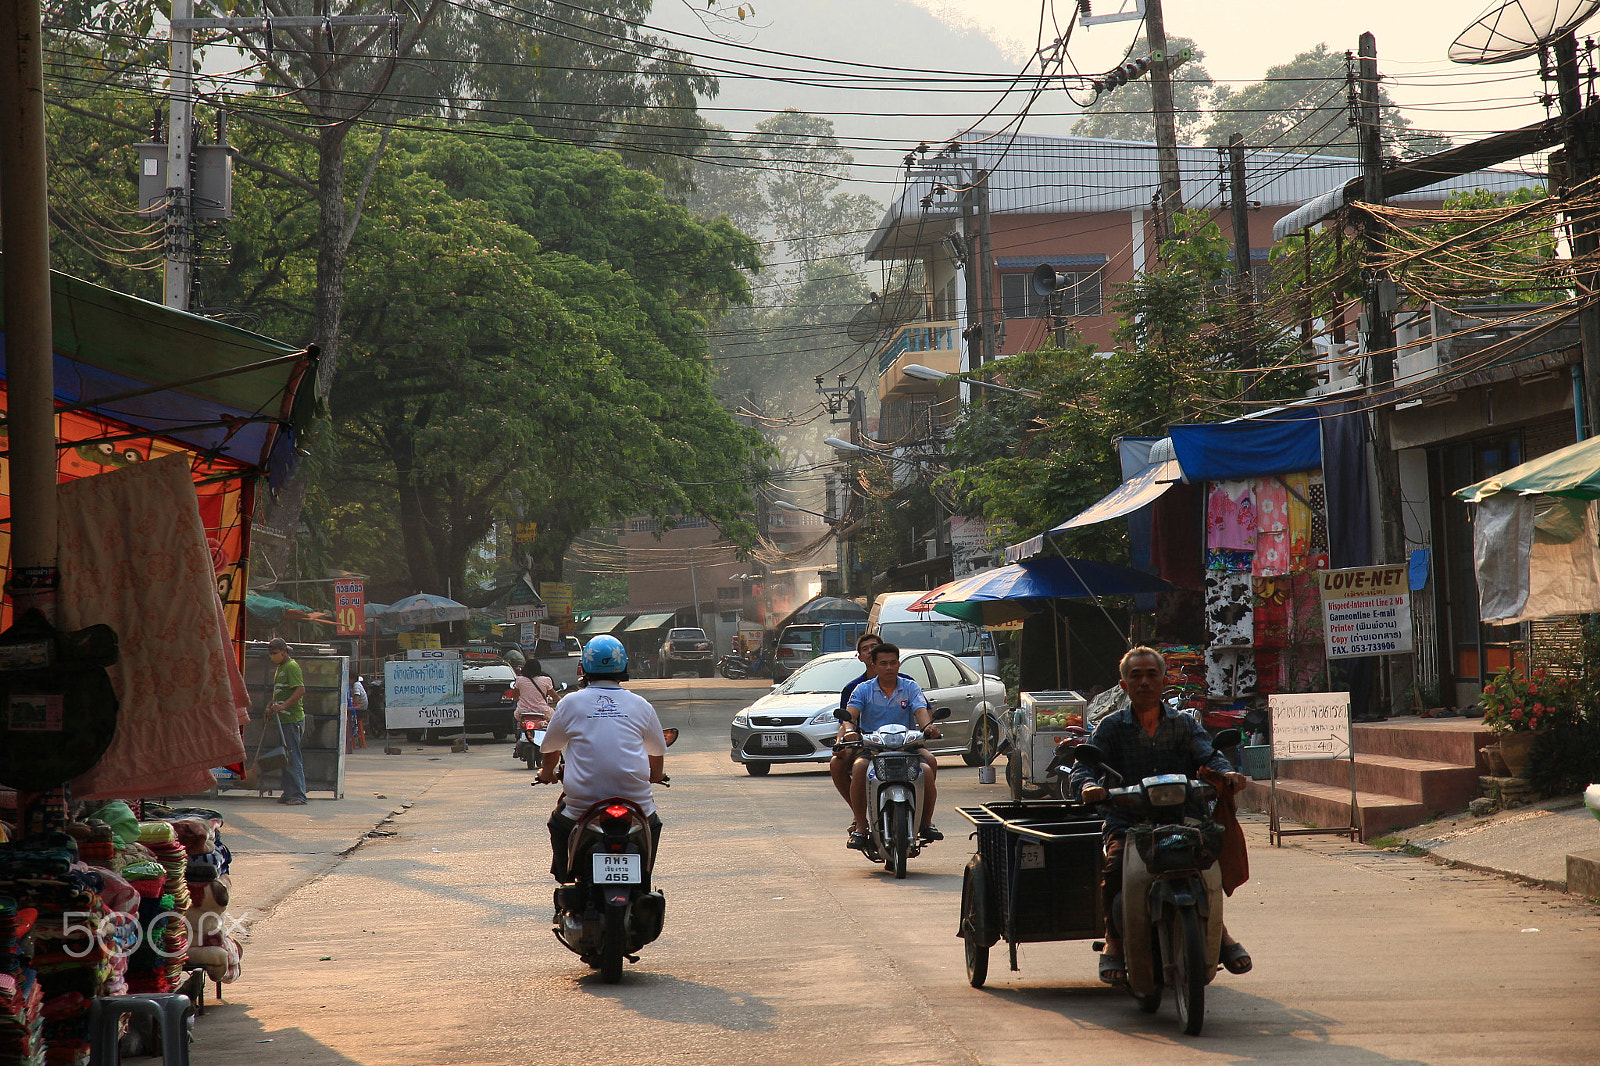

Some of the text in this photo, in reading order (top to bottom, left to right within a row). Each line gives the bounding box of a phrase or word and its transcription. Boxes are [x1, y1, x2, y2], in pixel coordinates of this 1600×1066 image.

[1324, 569, 1404, 590] LOVE-NET
[338, 608, 356, 632] 10
[1329, 609, 1396, 621] Gameonline E-mail
[1330, 623, 1355, 632] Printer
[1331, 635, 1349, 645] Copy
[1332, 642, 1396, 655] FAX. 053-733906
[418, 707, 460, 718] รับฝากรถ
[428, 718, 441, 726] 40
[605, 873, 629, 882] 455
